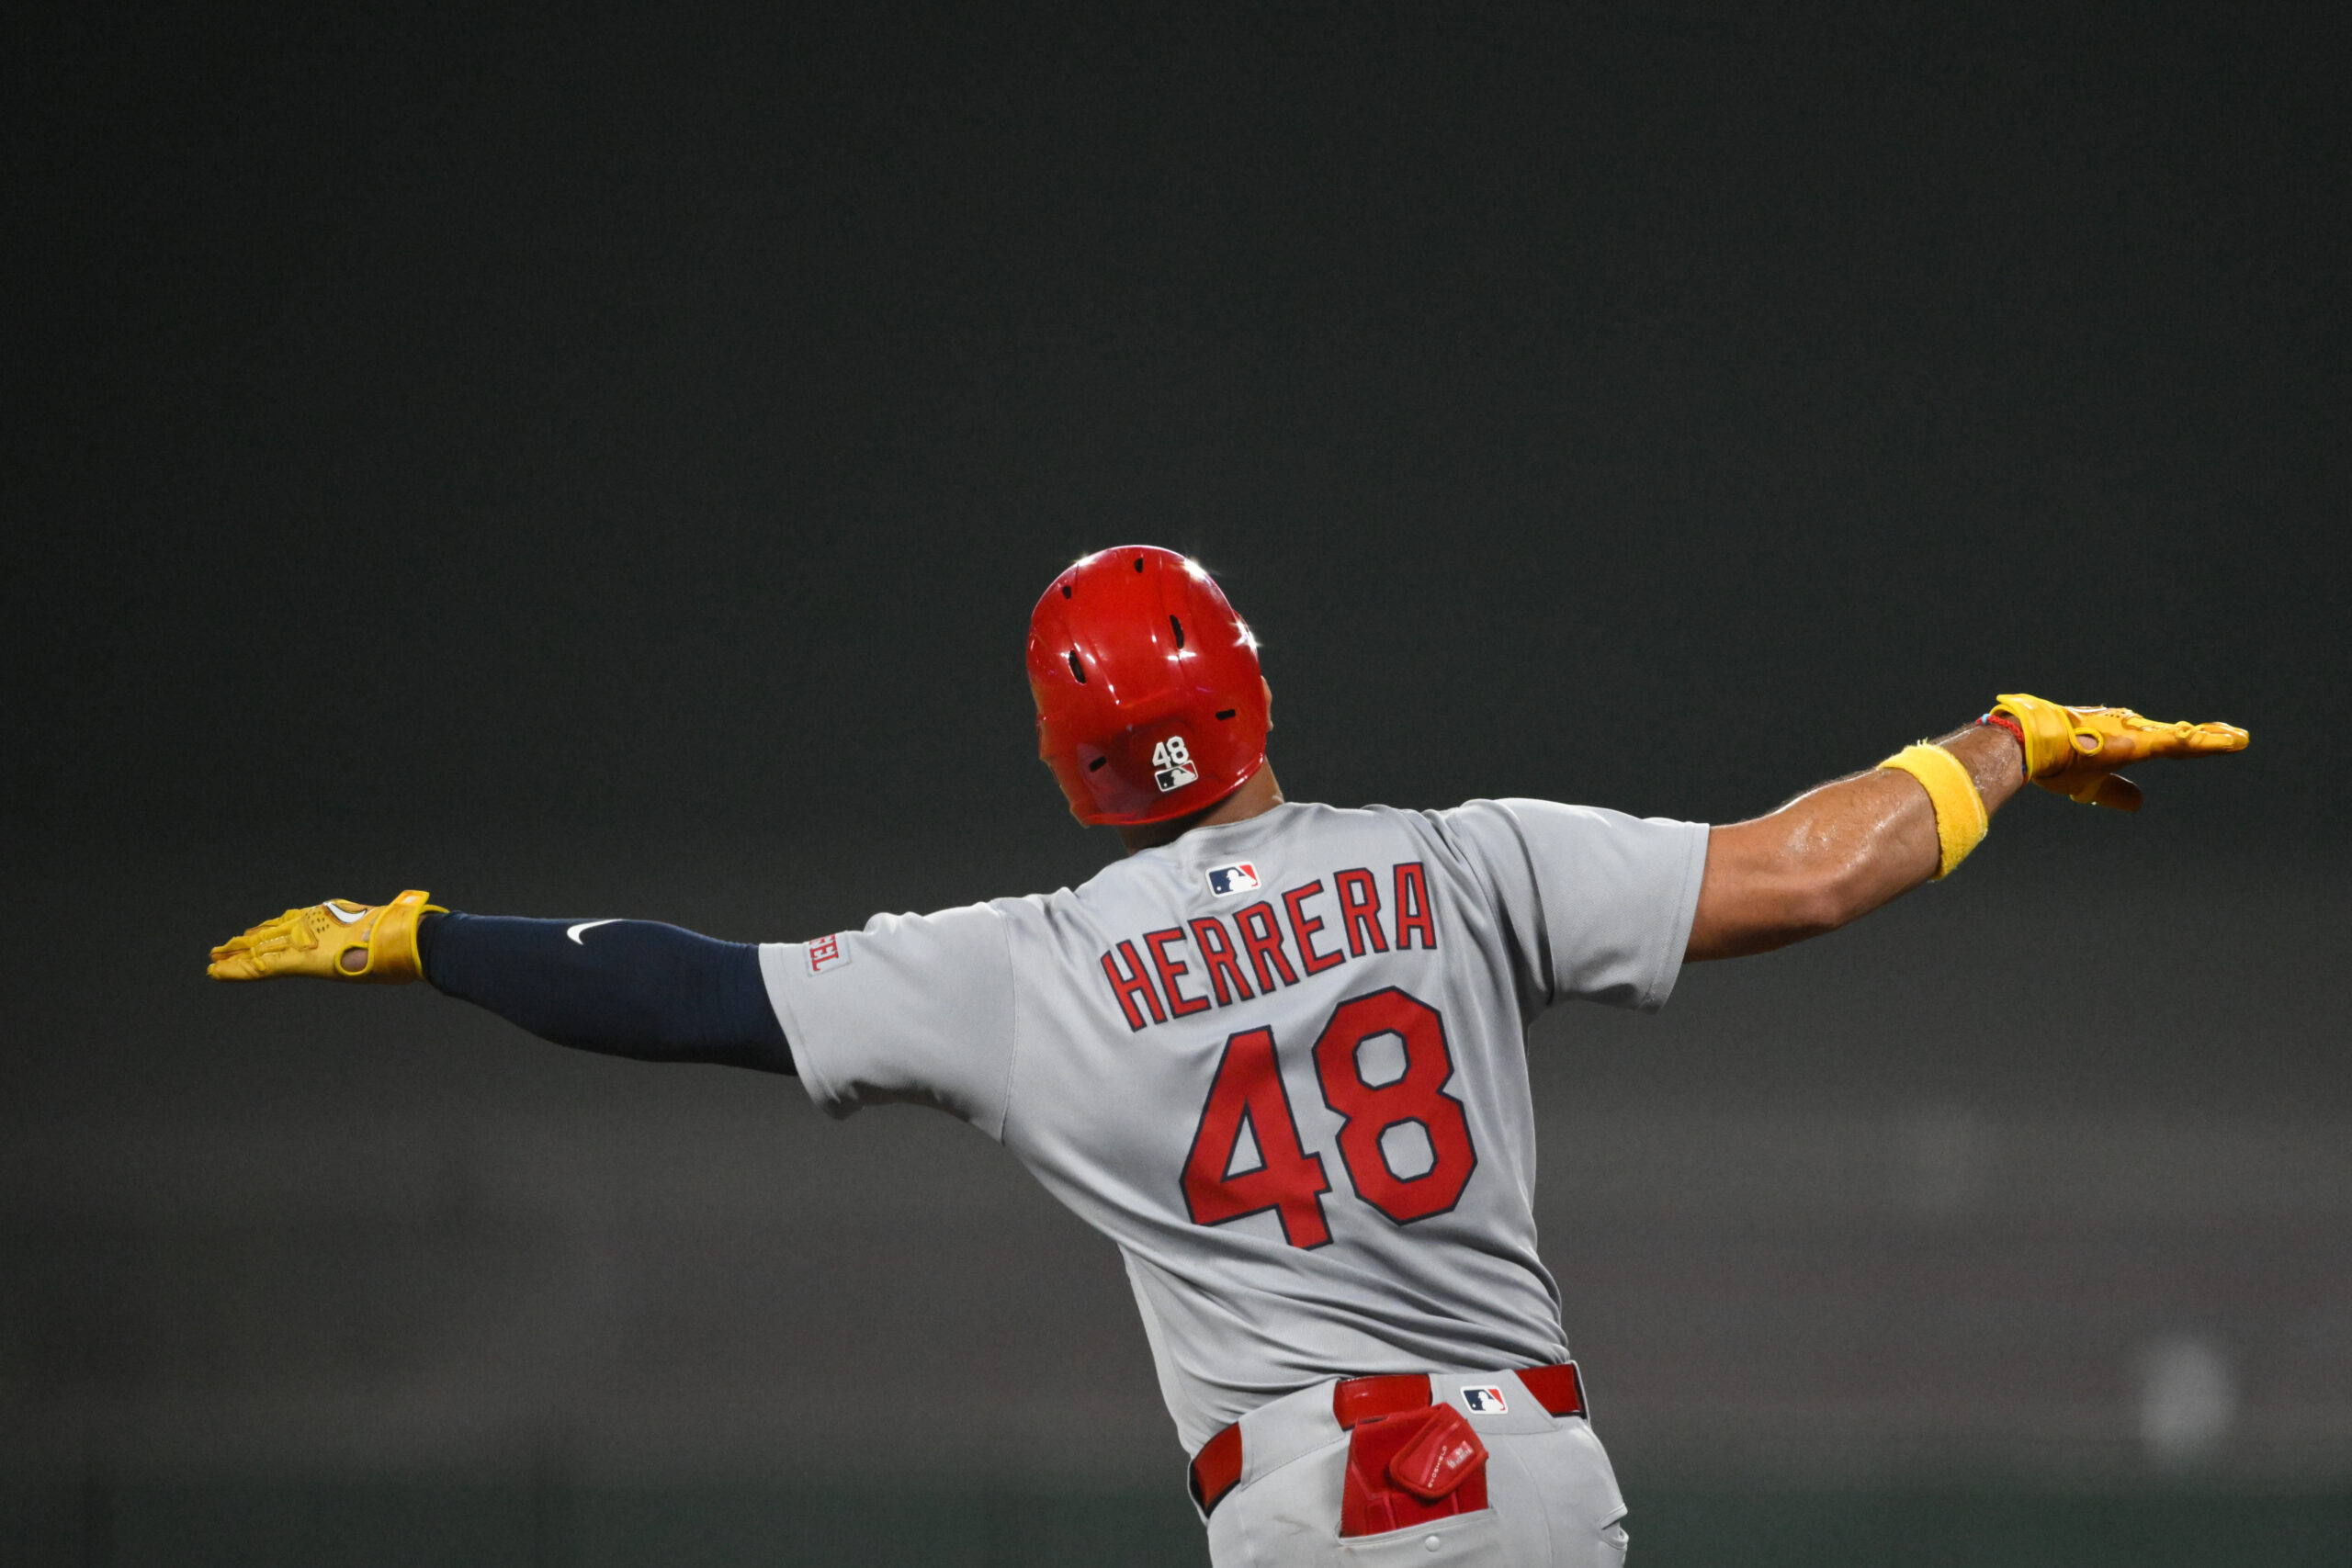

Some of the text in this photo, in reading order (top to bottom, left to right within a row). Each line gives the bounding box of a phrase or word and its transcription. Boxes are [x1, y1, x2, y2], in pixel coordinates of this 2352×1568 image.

[1152, 736, 1190, 769] 48
[1101, 862, 1437, 1032] HERRERA
[1179, 985, 1477, 1250] 48
